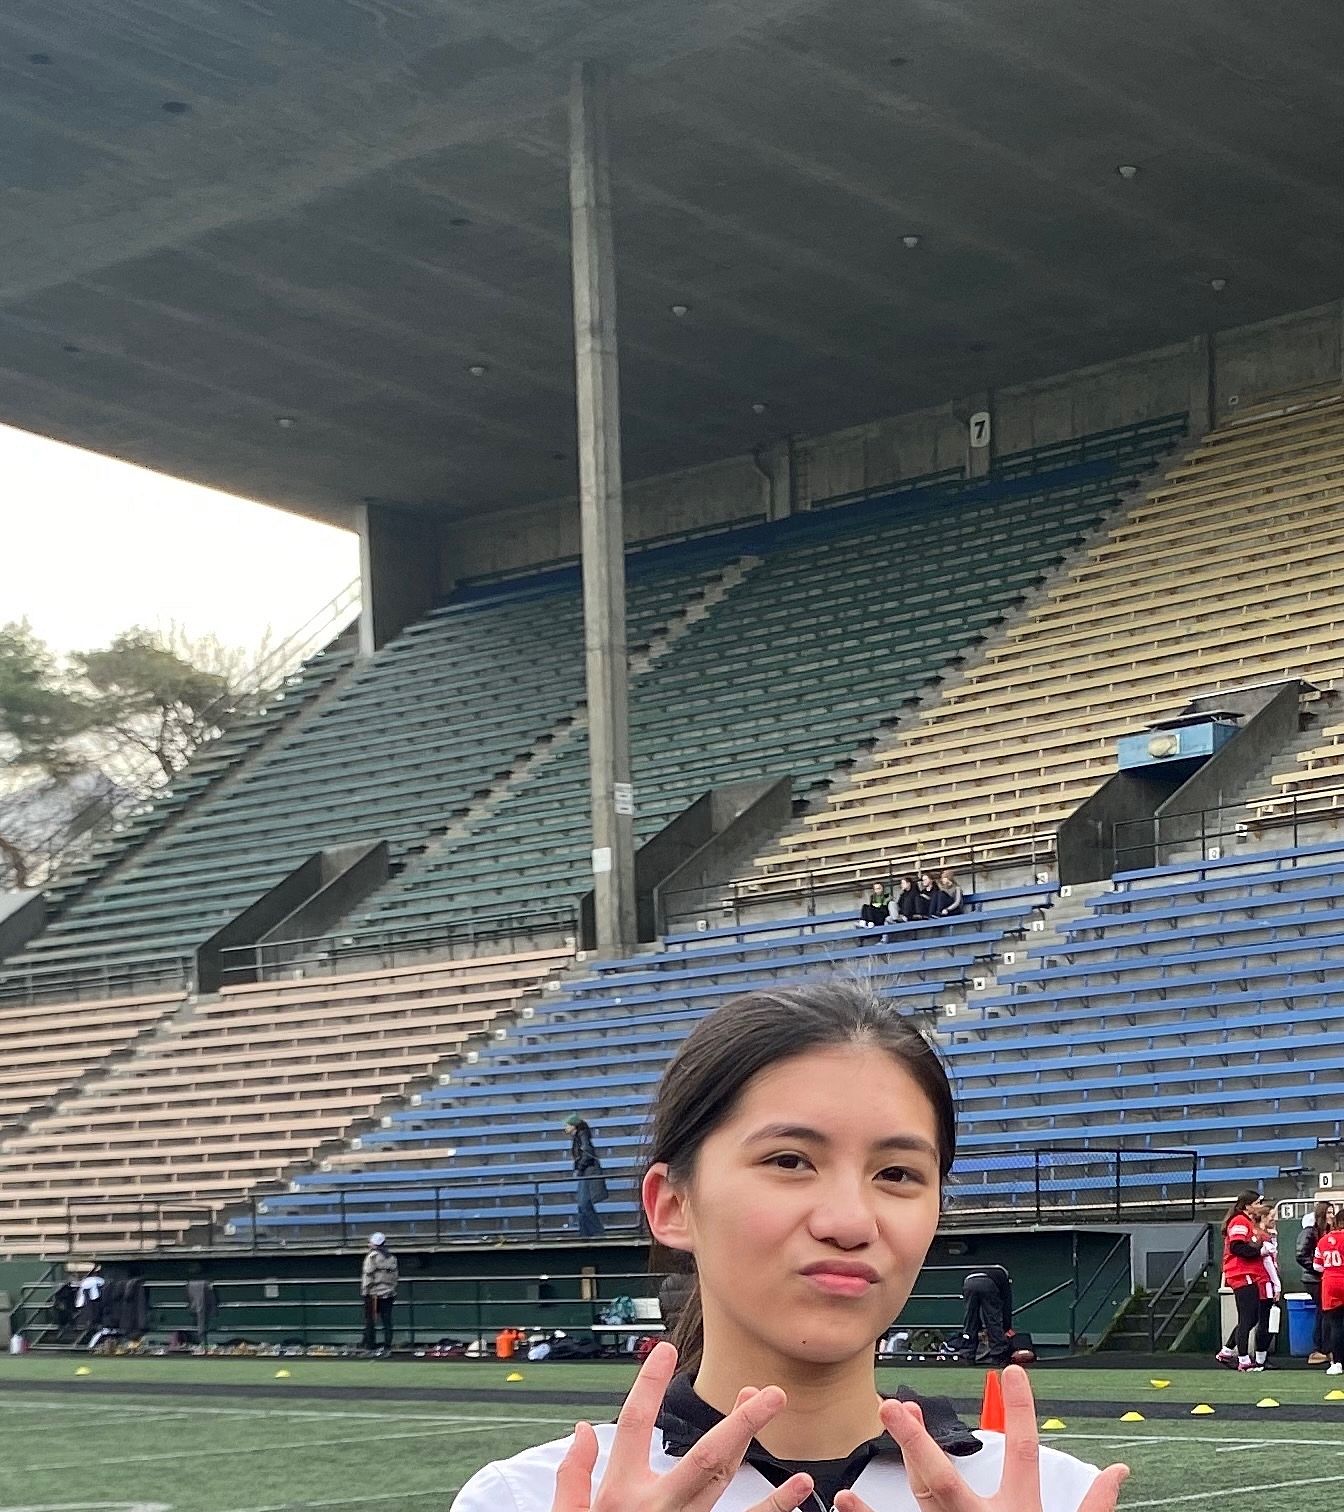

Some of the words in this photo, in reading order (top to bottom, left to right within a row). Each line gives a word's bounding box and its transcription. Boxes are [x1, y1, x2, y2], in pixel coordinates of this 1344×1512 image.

[974, 420, 986, 440] 7
[1322, 1175, 1330, 1186] D
[1323, 1250, 1342, 1267] 20
